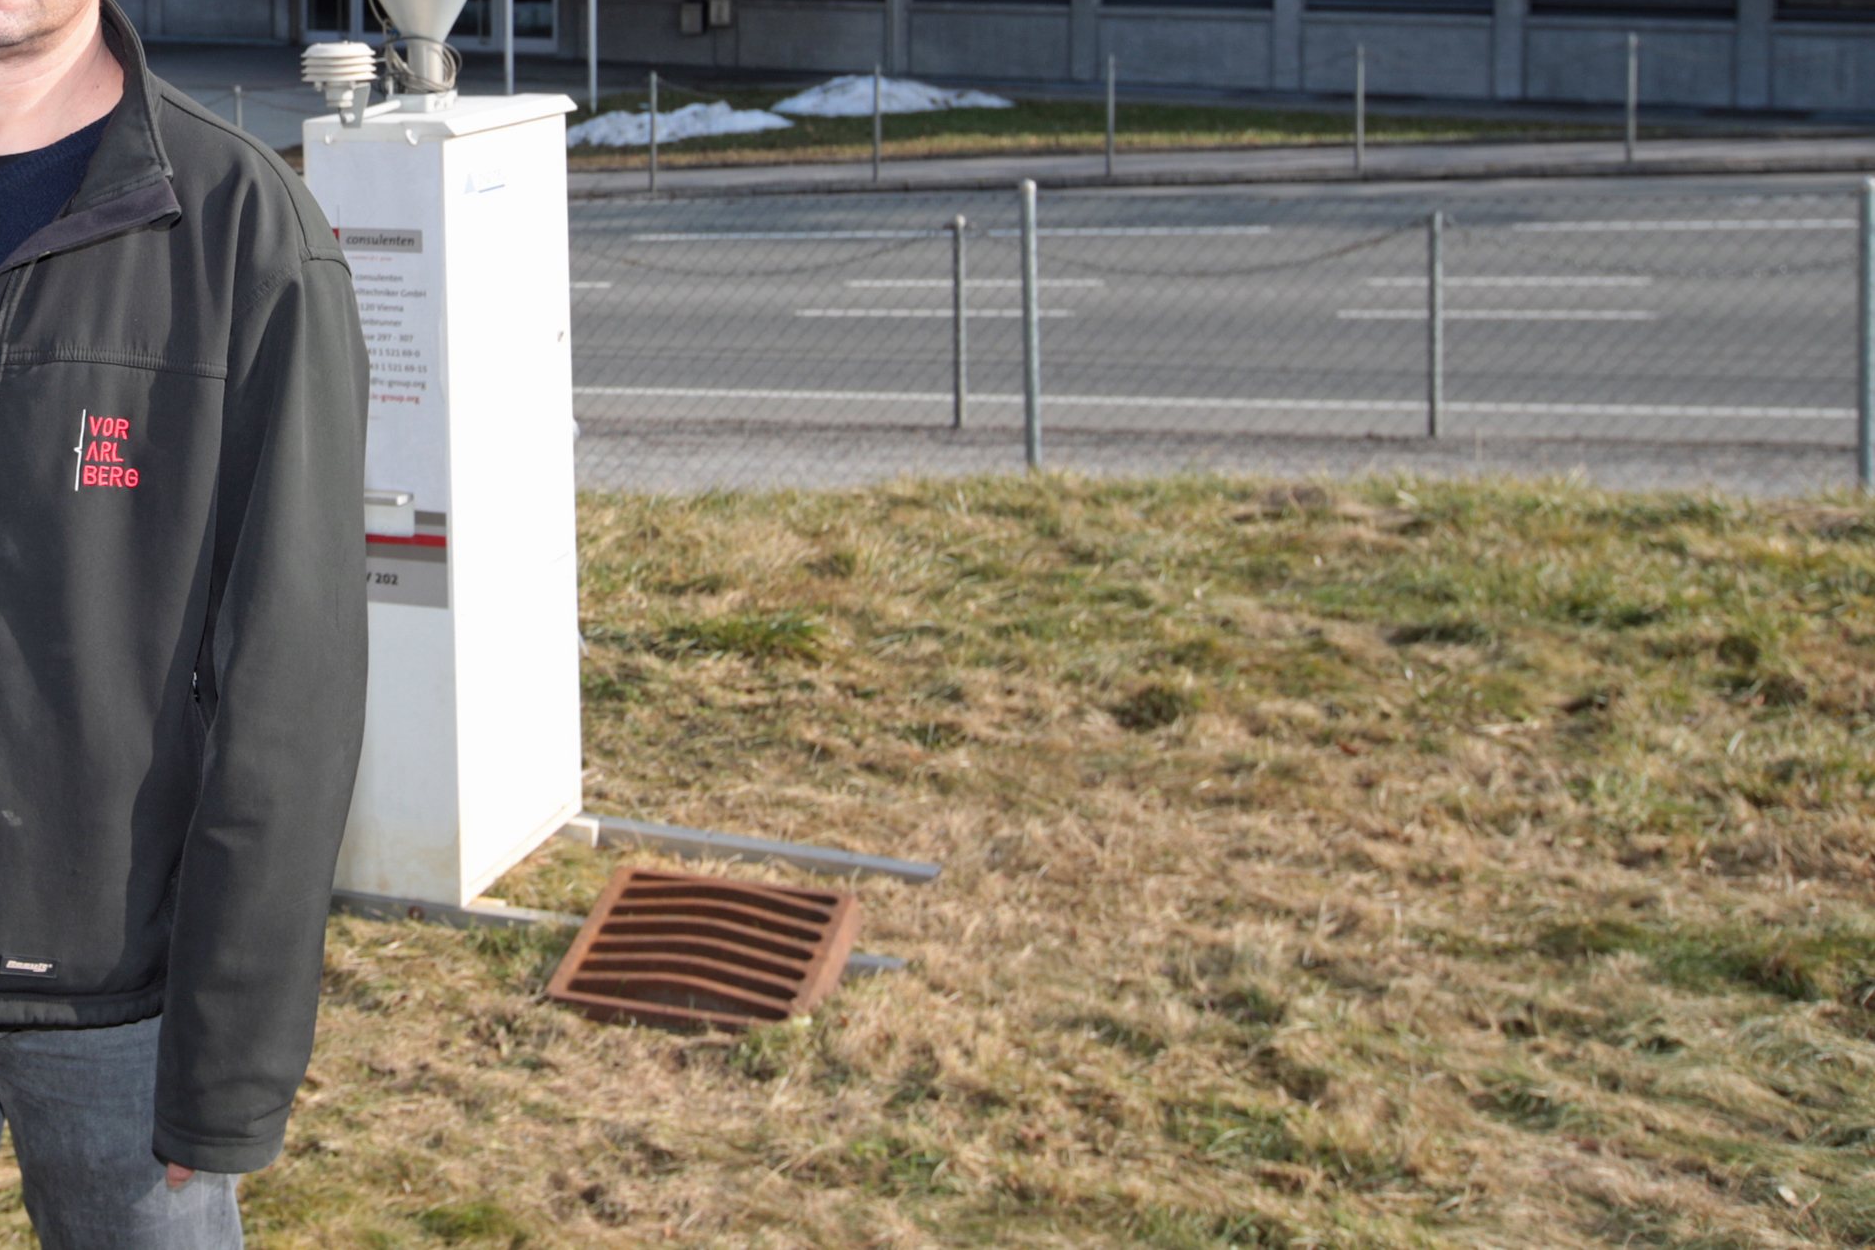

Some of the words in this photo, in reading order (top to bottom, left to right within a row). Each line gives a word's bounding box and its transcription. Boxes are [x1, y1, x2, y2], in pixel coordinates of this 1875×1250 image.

[346, 233, 415, 247] consulenten
[370, 376, 427, 391] @ic-group.org
[88, 415, 131, 441] VOR
[84, 440, 125, 463] ARL
[82, 464, 140, 488] BERG
[374, 572, 399, 586] 202
